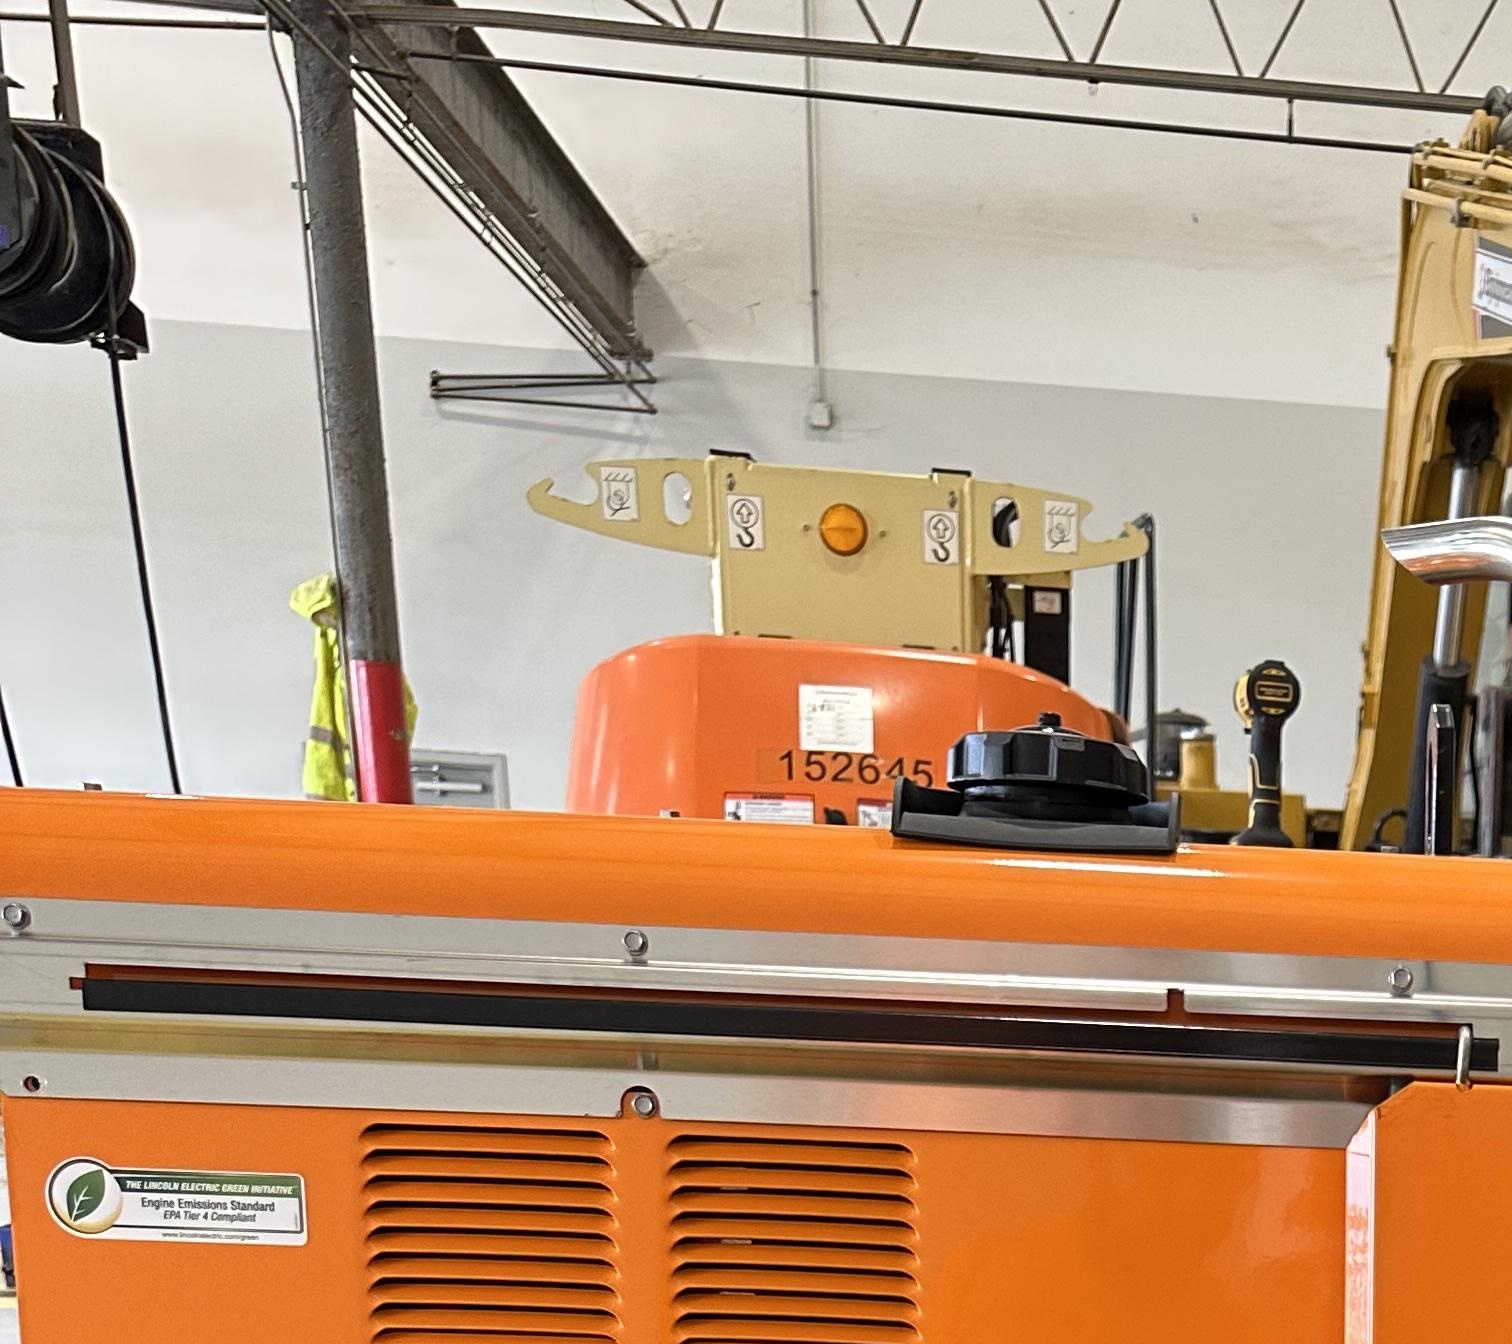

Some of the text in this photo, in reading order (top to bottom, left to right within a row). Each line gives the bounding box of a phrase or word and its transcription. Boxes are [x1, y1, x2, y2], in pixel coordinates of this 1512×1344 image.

[779, 749, 934, 789] 152645
[126, 1180, 294, 1195] THE LINCOLN ELECTRIC GREEN INITIATIVE
[141, 1197, 275, 1212] Engine Emissions Standard
[164, 1210, 257, 1223] EPA Tier 4 Compliant
